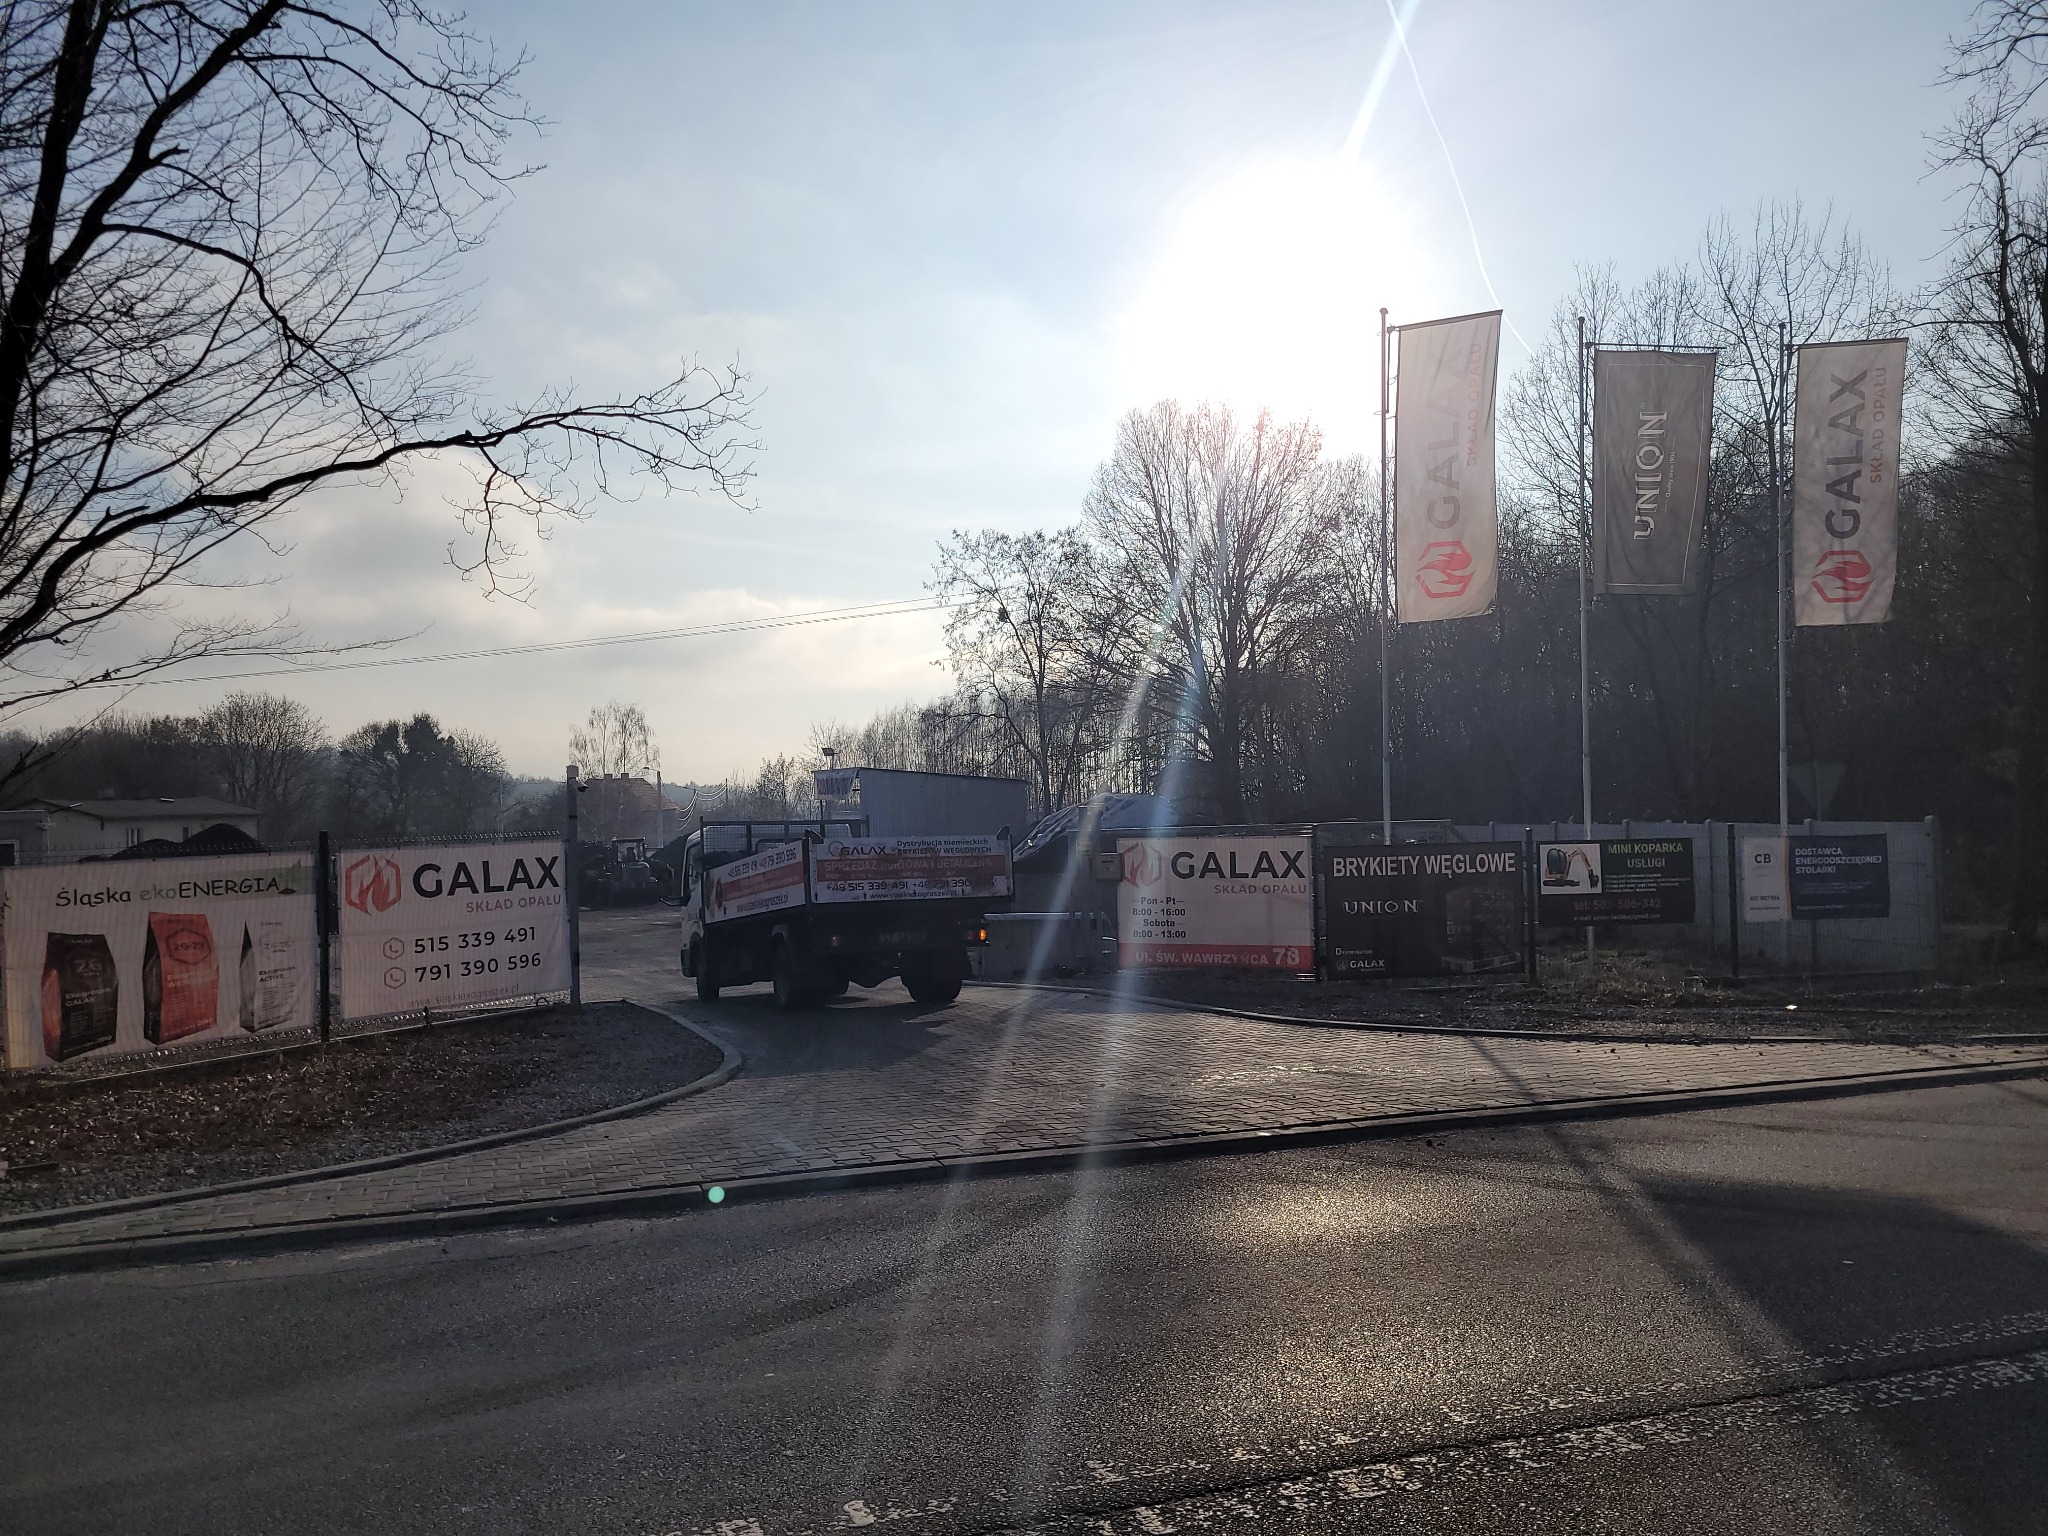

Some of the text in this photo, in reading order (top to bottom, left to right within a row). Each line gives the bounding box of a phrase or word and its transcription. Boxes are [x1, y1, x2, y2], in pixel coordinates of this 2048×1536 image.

[1467, 343, 1482, 466] SKŁAD OPAŁU
[1870, 367, 1889, 484] SKŁAD OPAŁU
[1426, 346, 1463, 529] GALAX
[1824, 369, 1868, 540] GALAX
[1633, 411, 1668, 541] UNION
[840, 845, 887, 856] GALAX
[1608, 842, 1684, 855] MINI KOPARKA
[1795, 847, 1843, 856] DOSTAWCA
[1170, 850, 1306, 880] GALAX
[1333, 852, 1516, 879] BRYKIETY WĘGLOWE
[1627, 857, 1667, 868] USŁUGI
[1754, 853, 1772, 864] CB
[1795, 855, 1882, 867] ENERGOOSZCZĘDNEJ
[412, 855, 561, 899] GALAX
[1795, 866, 1837, 875] STOLARKI
[848, 882, 865, 892] 515
[867, 881, 888, 892] 339
[1214, 884, 1307, 894] SKŁAD OPAŁU
[54, 884, 132, 908] Śląska
[1140, 896, 1158, 906] Pon
[1166, 896, 1176, 906] Pt
[466, 894, 562, 913] SKŁAD OPAŁU
[1342, 899, 1420, 915] UNION
[1132, 907, 1152, 916] 8:00
[1160, 907, 1186, 917] 16:00
[1143, 918, 1176, 928] Sobota
[413, 926, 537, 955] 515 339 491
[1133, 930, 1152, 939] 8:00
[1160, 930, 1187, 939] 13:00
[1156, 950, 1179, 963] ŚW.
[1182, 952, 1269, 966] WAWRZYŃCA
[1272, 947, 1300, 966] 78
[413, 952, 542, 984] 791 390 596
[1349, 959, 1386, 969] GALAX
